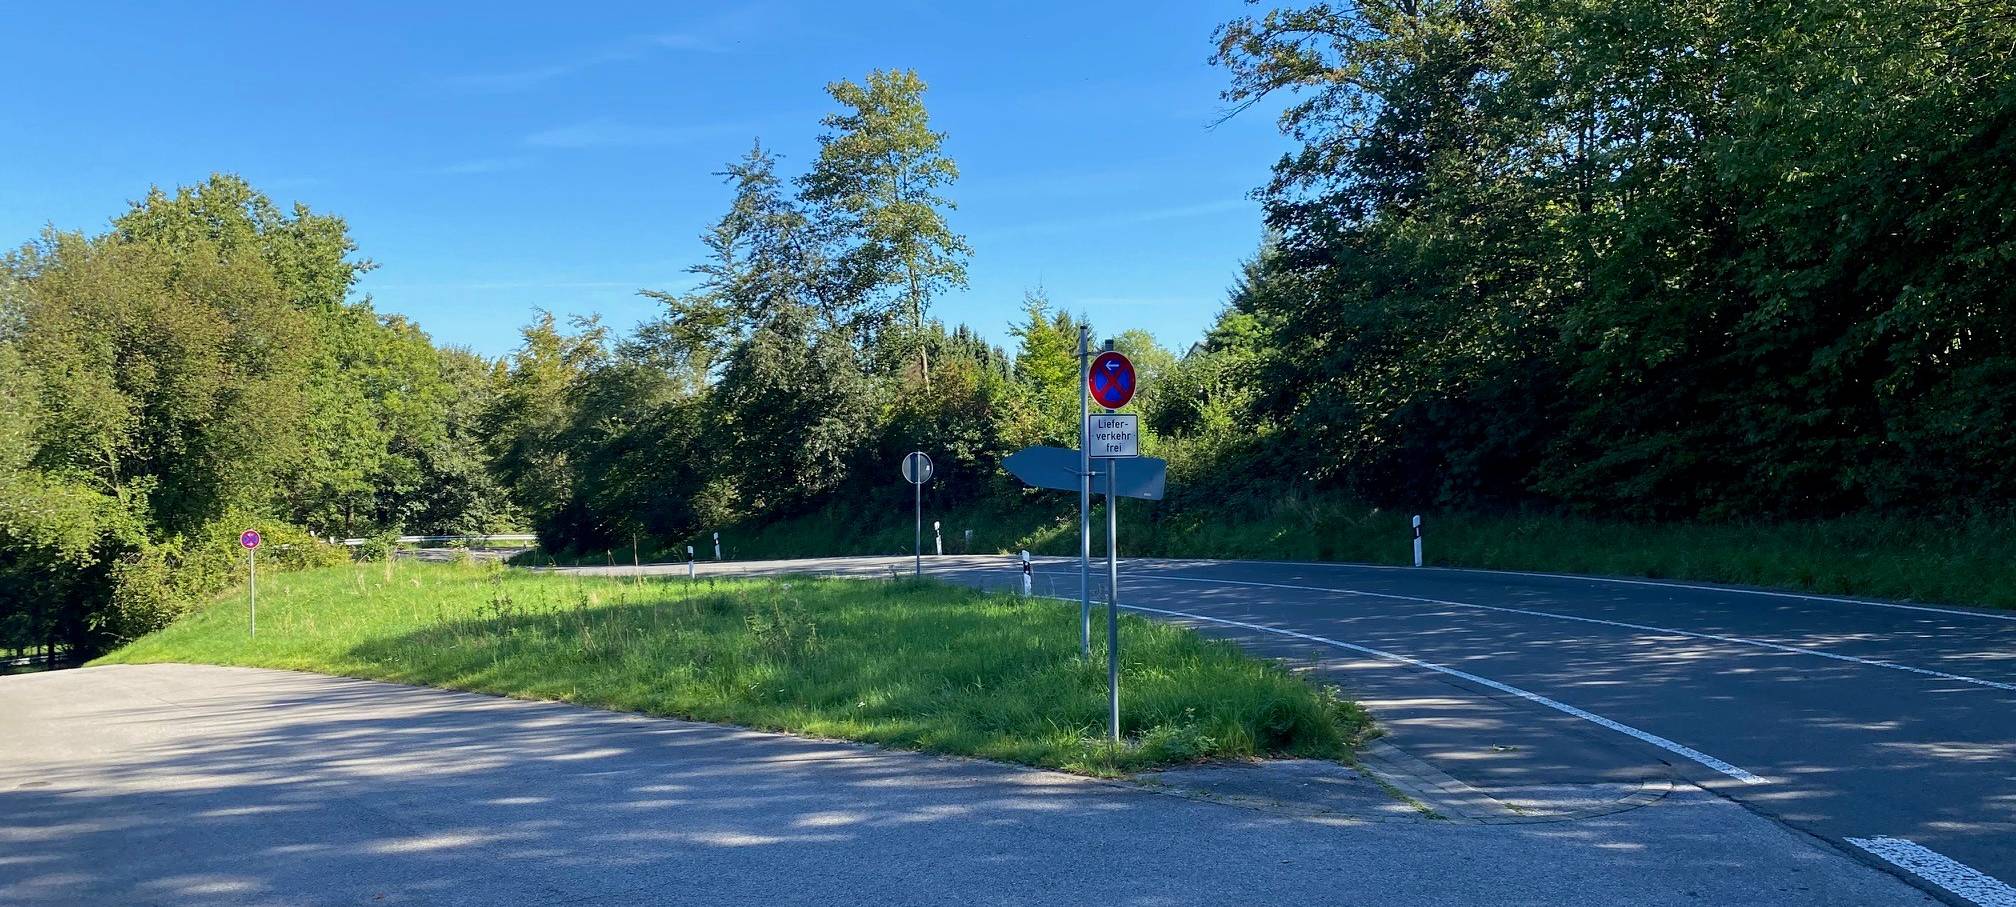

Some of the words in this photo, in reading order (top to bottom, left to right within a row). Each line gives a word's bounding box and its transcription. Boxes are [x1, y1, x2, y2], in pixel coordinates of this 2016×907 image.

[1098, 419, 1128, 428] Liefer-
[1096, 431, 1131, 440] verkehr
[1106, 443, 1122, 452] frei
